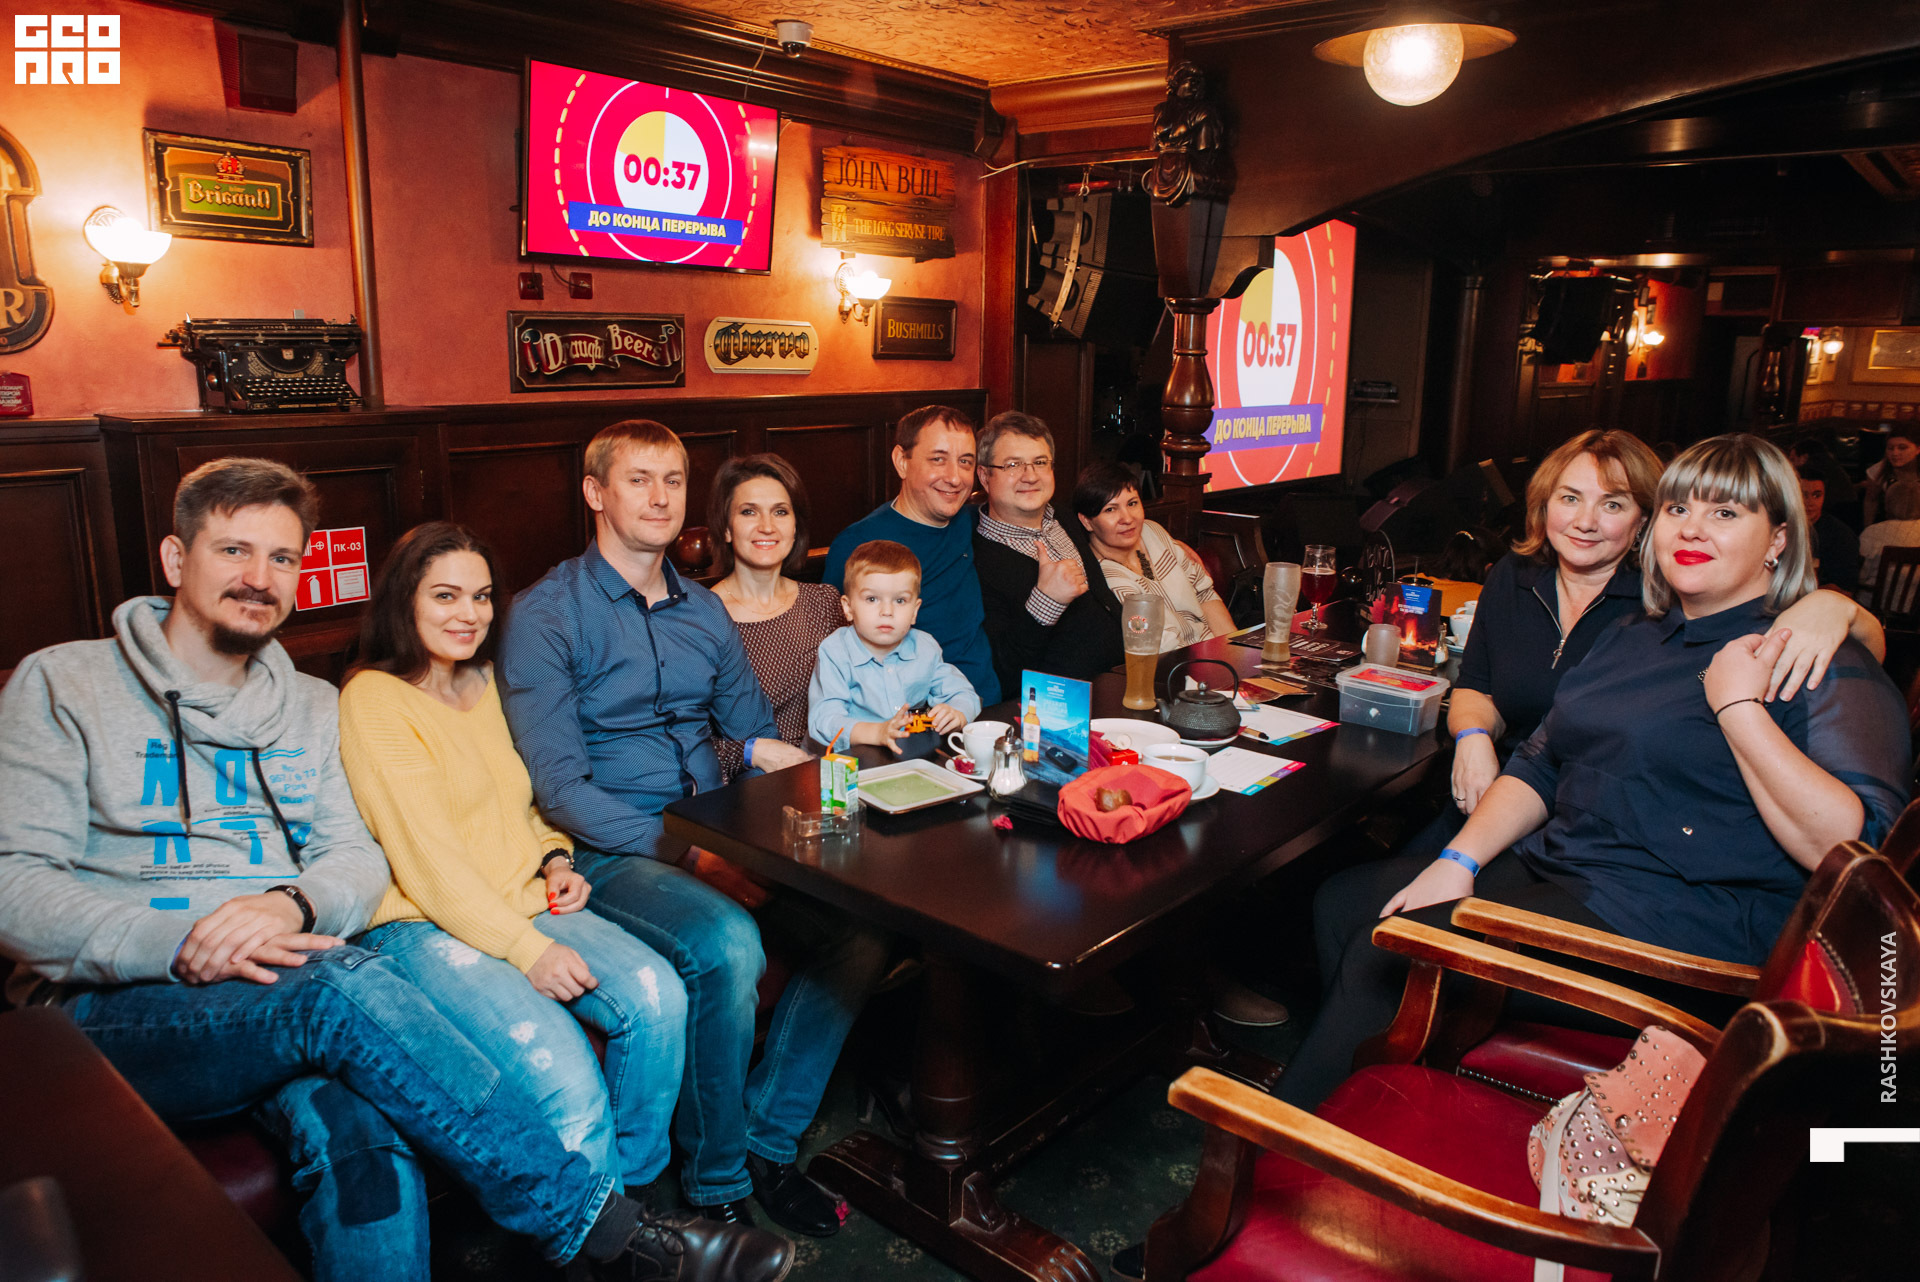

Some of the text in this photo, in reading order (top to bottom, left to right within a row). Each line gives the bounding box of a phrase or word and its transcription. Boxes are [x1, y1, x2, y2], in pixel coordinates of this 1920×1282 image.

[624, 154, 701, 191] 00:37
[897, 165, 942, 198] BULL
[588, 210, 726, 238] ДО КОНЦА ПЕРЕРЫВА
[854, 218, 872, 235] THE
[607, 323, 662, 361] Beers
[714, 322, 810, 366] Cuervo
[887, 319, 944, 340] BUSHMILLS
[1243, 320, 1297, 367] 00:37
[1214, 413, 1311, 445] ДО КОНЦА ПЕРЕРЫВА
[333, 541, 362, 553] ПК-03
